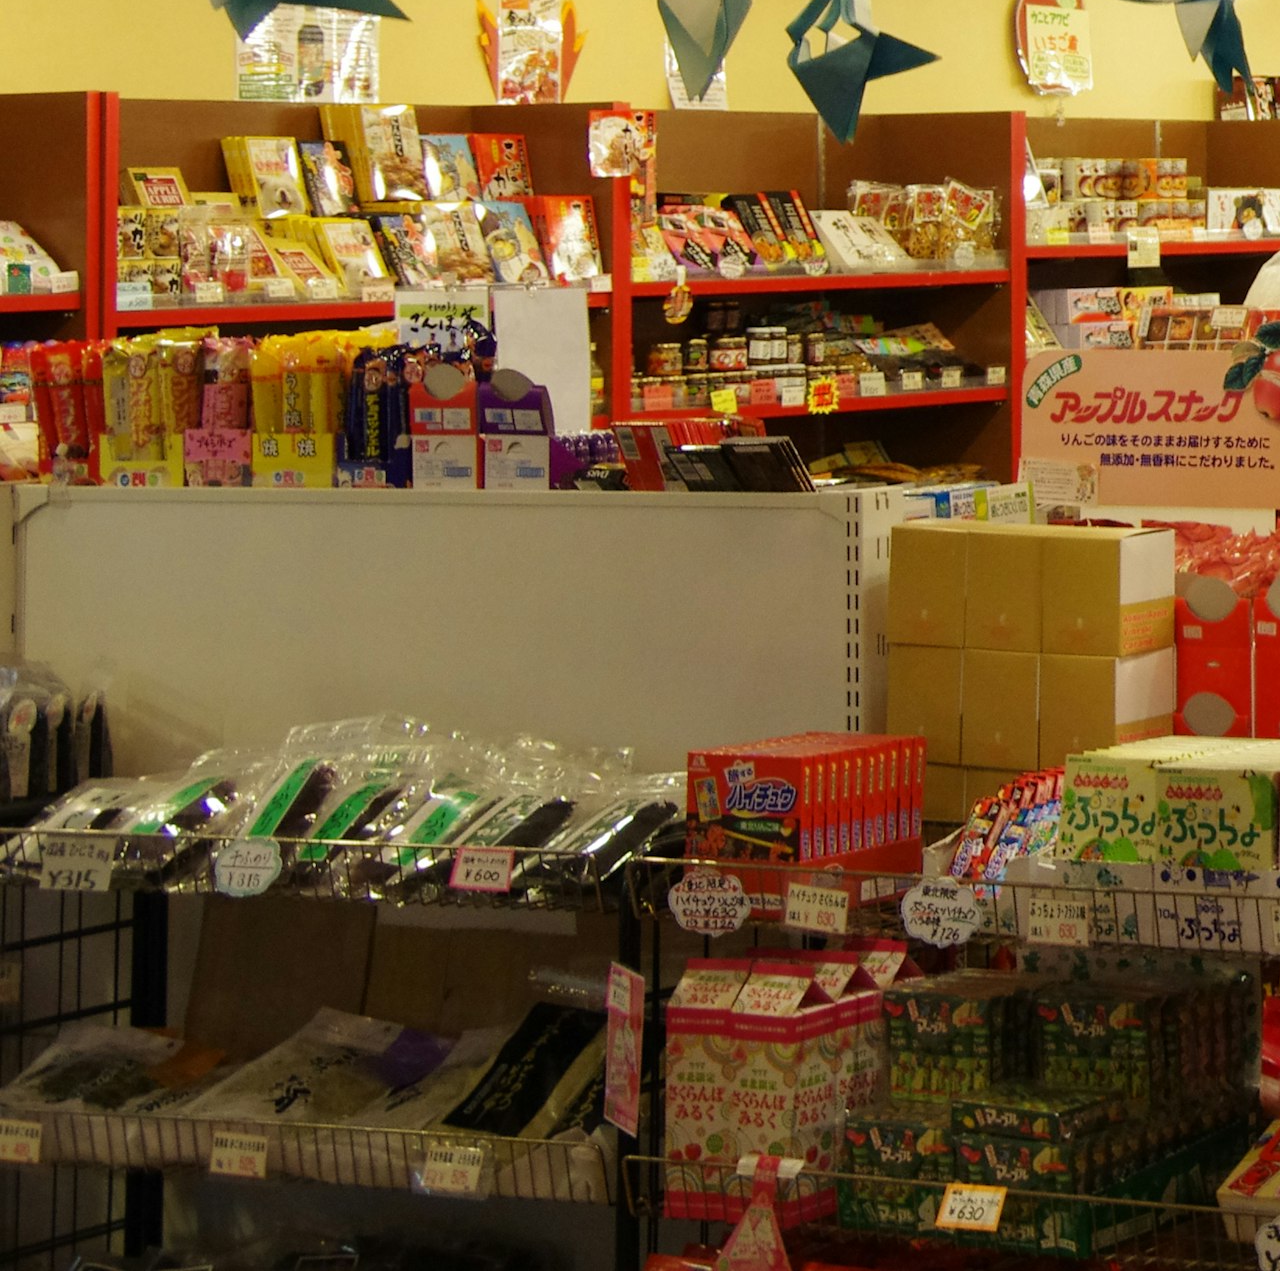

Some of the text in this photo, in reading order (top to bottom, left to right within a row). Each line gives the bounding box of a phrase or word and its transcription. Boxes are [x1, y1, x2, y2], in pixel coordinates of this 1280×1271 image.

[147, 185, 178, 195] APPLE
[1027, 355, 1080, 405] 青森県産
[1049, 386, 1245, 423] アップルスナック
[1060, 434, 1271, 449] りんごの味をそのままお届けするために
[1099, 452, 1275, 470] 無添加・無香料にこだわりました。
[726, 781, 797, 812] ハイチュウ
[1067, 795, 1156, 836] ぷっちょ
[1164, 802, 1261, 845] ぷっちょ
[463, 869, 501, 882] ¥600
[668, 1084, 725, 1103] さくらんぼ
[731, 1091, 787, 1111] さくらんぼ
[675, 1103, 716, 1120] みるく
[738, 1109, 777, 1129] みるく
